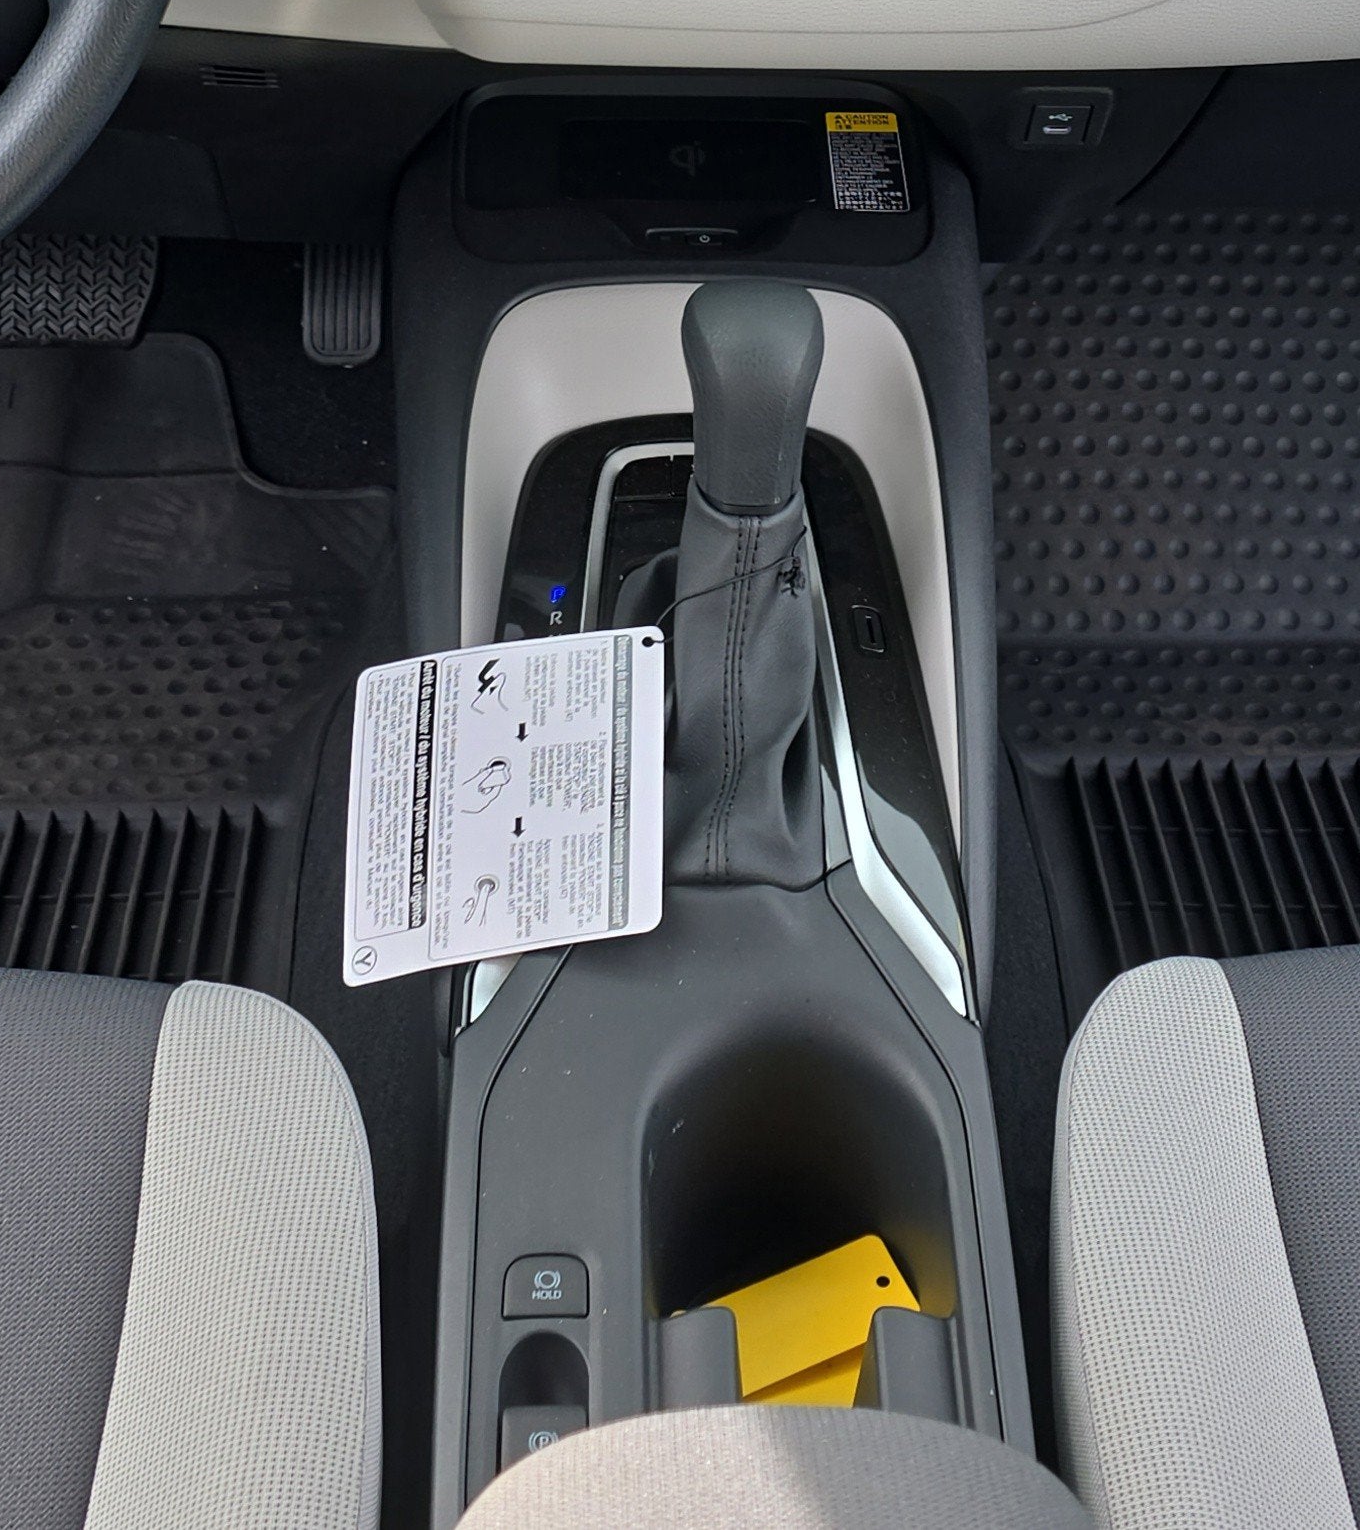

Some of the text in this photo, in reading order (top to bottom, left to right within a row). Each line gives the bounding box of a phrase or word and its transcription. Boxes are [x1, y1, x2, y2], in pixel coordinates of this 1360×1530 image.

[550, 611, 562, 625] R
[421, 661, 435, 684] Arrêt
[421, 685, 434, 698] du
[418, 700, 432, 734] moteur
[417, 740, 430, 754] du
[413, 755, 429, 797] système
[411, 798, 428, 837] hybride
[413, 838, 424, 852] en
[413, 853, 423, 872] cas
[408, 873, 425, 927] d'urgence
[532, 1289, 561, 1300] HOLD
